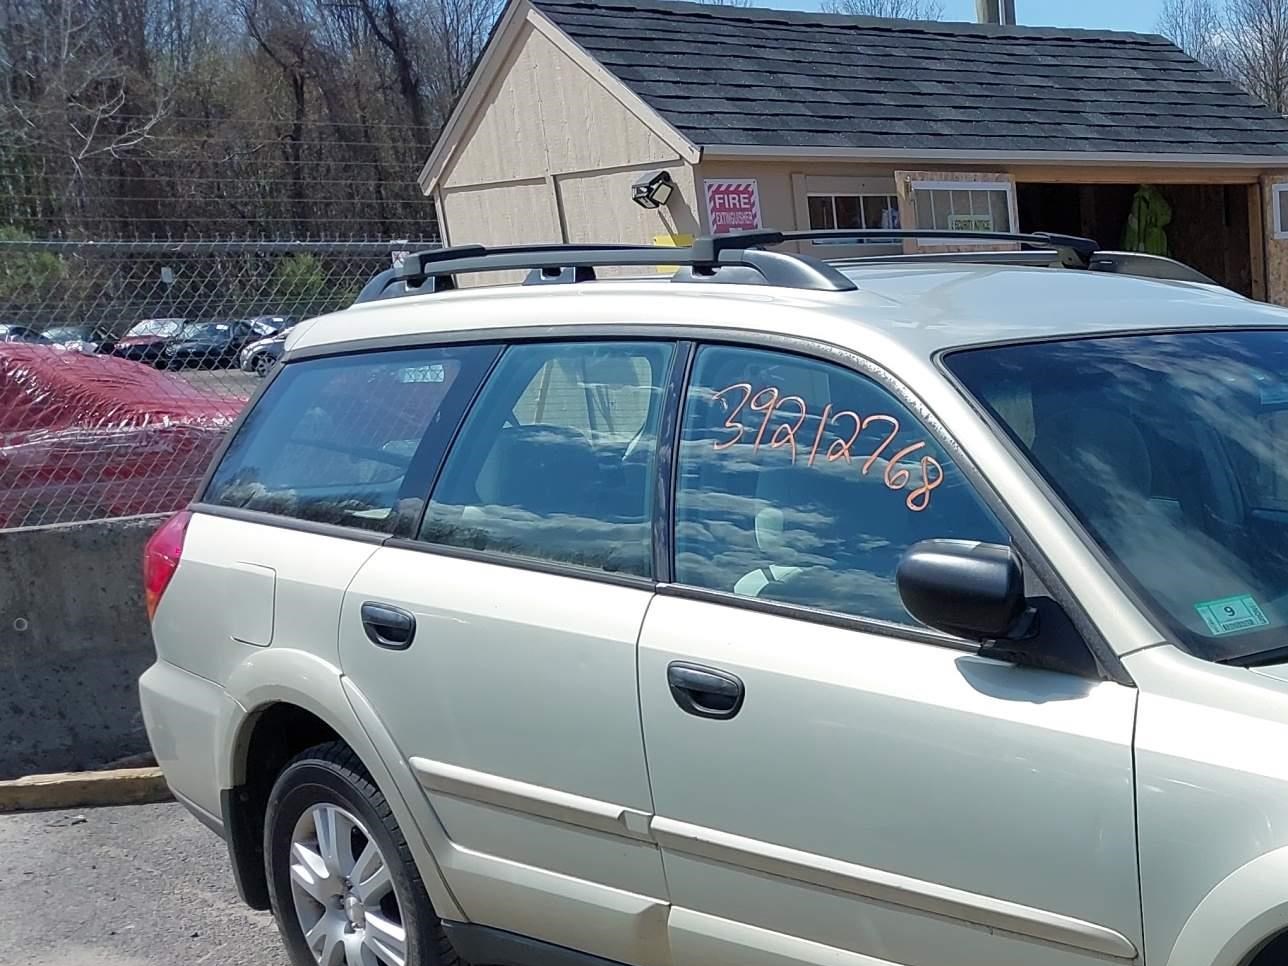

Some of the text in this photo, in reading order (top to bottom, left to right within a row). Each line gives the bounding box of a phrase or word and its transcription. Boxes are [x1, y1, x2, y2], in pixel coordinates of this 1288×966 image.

[714, 193, 751, 209] FIRE
[712, 384, 944, 512] 39212768
[1223, 605, 1236, 617] 9
